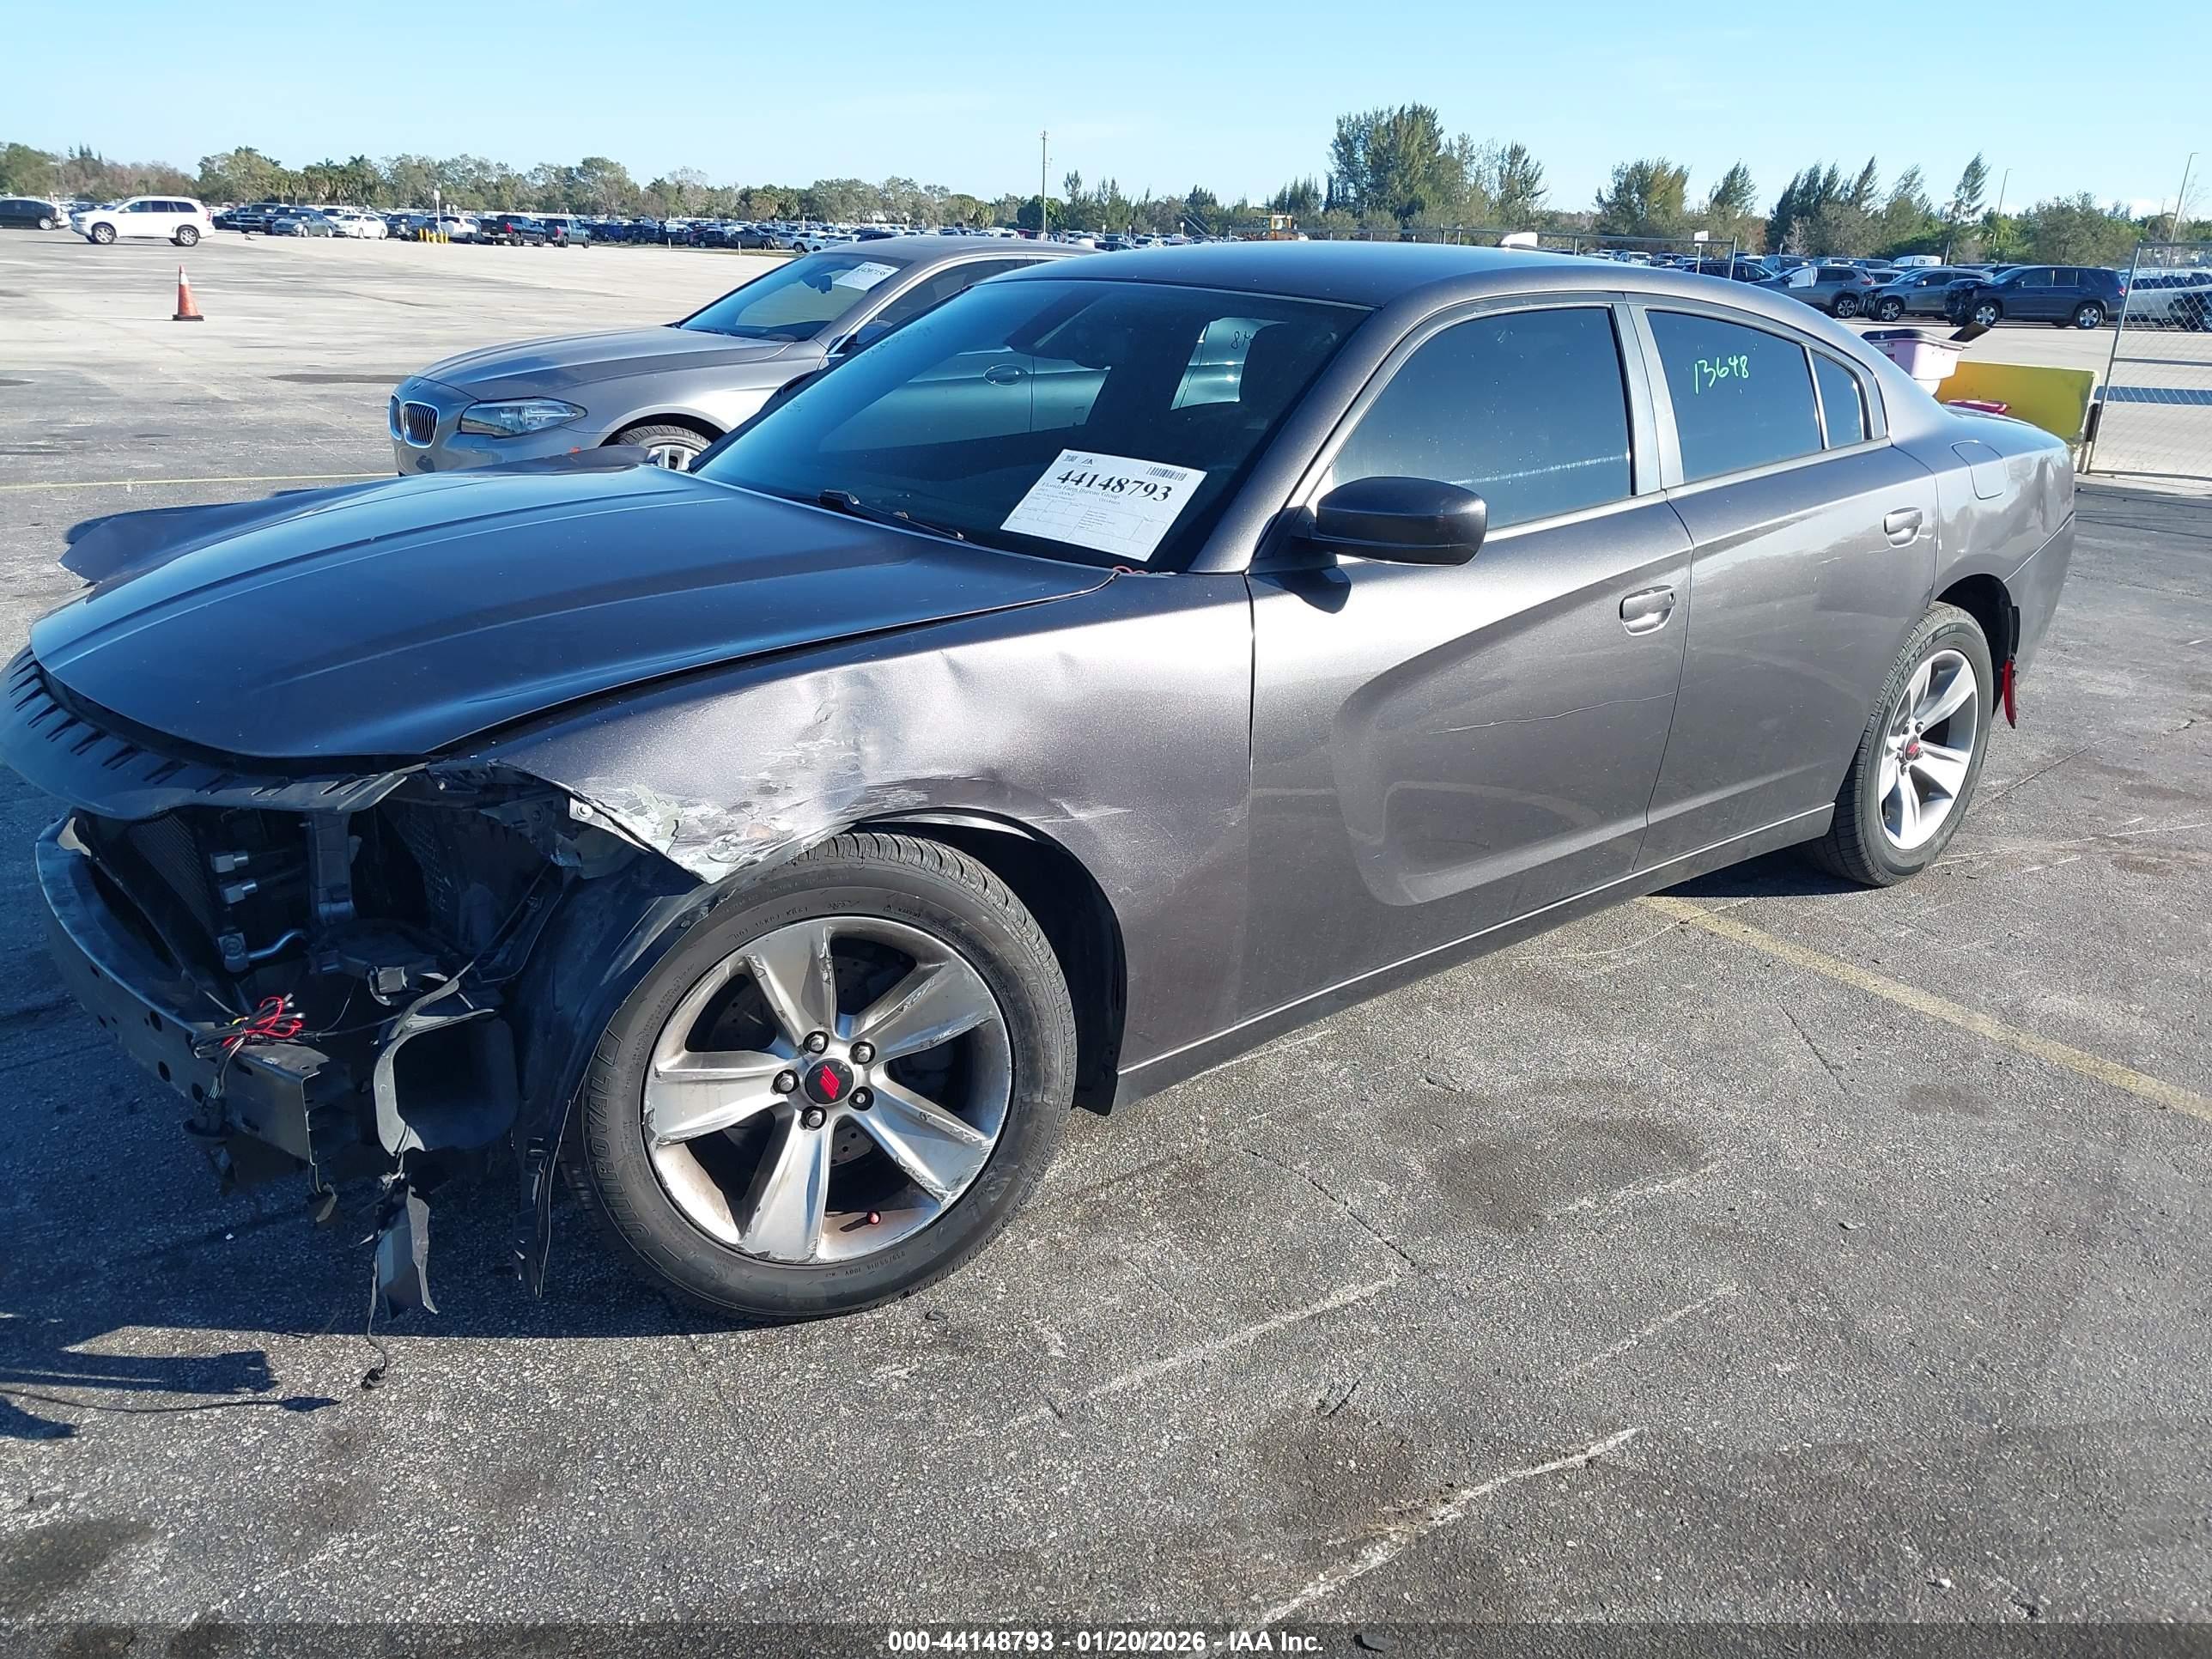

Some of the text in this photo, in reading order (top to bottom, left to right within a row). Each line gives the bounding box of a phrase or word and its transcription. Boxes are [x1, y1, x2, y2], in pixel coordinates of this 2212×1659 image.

[1694, 355, 1749, 395] 13648
[1056, 468, 1174, 502] 44148793
[586, 1074, 651, 1241] UNIROYAL
